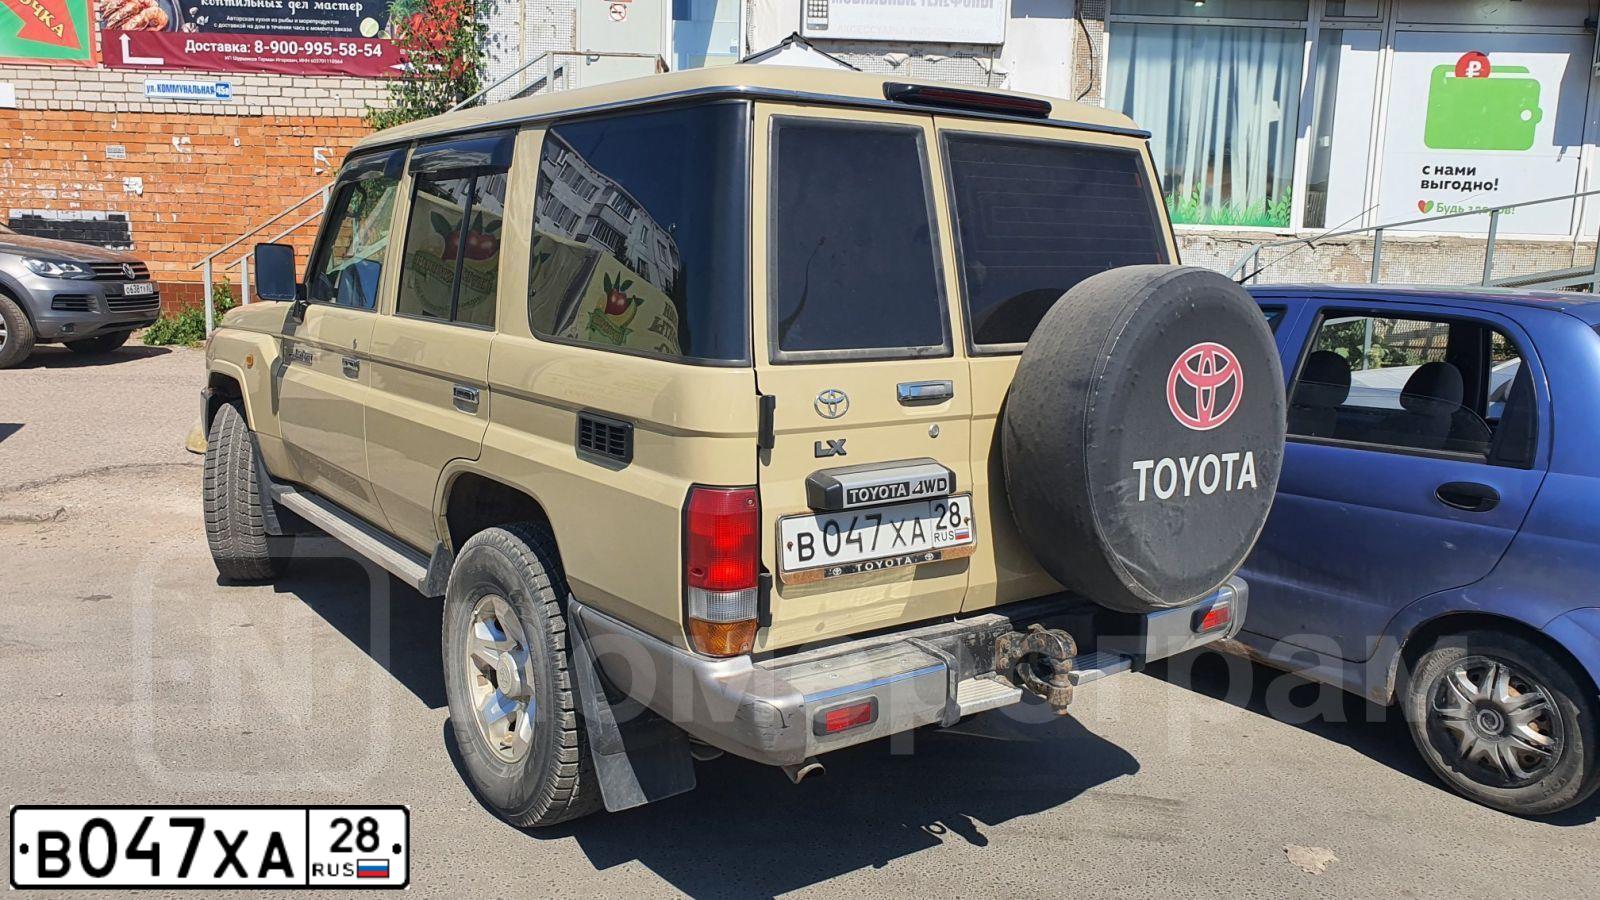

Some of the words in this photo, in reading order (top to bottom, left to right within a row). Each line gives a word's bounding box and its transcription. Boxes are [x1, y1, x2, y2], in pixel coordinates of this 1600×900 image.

[288, 1, 309, 16] дел
[314, 2, 363, 18] мастер
[226, 15, 255, 23] Авторская
[298, 18, 340, 26] морепродуктов
[185, 39, 251, 54] Доставка:
[254, 40, 383, 57] 8-900-995-58-54
[146, 84, 156, 94] ул.
[156, 83, 215, 95] КОММУНАЛЬНАЯ
[1422, 165, 1431, 175] с
[1434, 165, 1477, 176] нами
[1420, 178, 1499, 192] выгодно!
[1436, 202, 1465, 215] Будь
[1468, 205, 1516, 217] здов!
[814, 438, 847, 458] LX
[1132, 451, 1258, 502] TOYOTA
[849, 483, 908, 503] TOYOTA
[911, 477, 947, 496] 4WD
[934, 501, 962, 530] 28
[934, 530, 955, 543] RUS
[855, 556, 912, 572] TOYOTA
